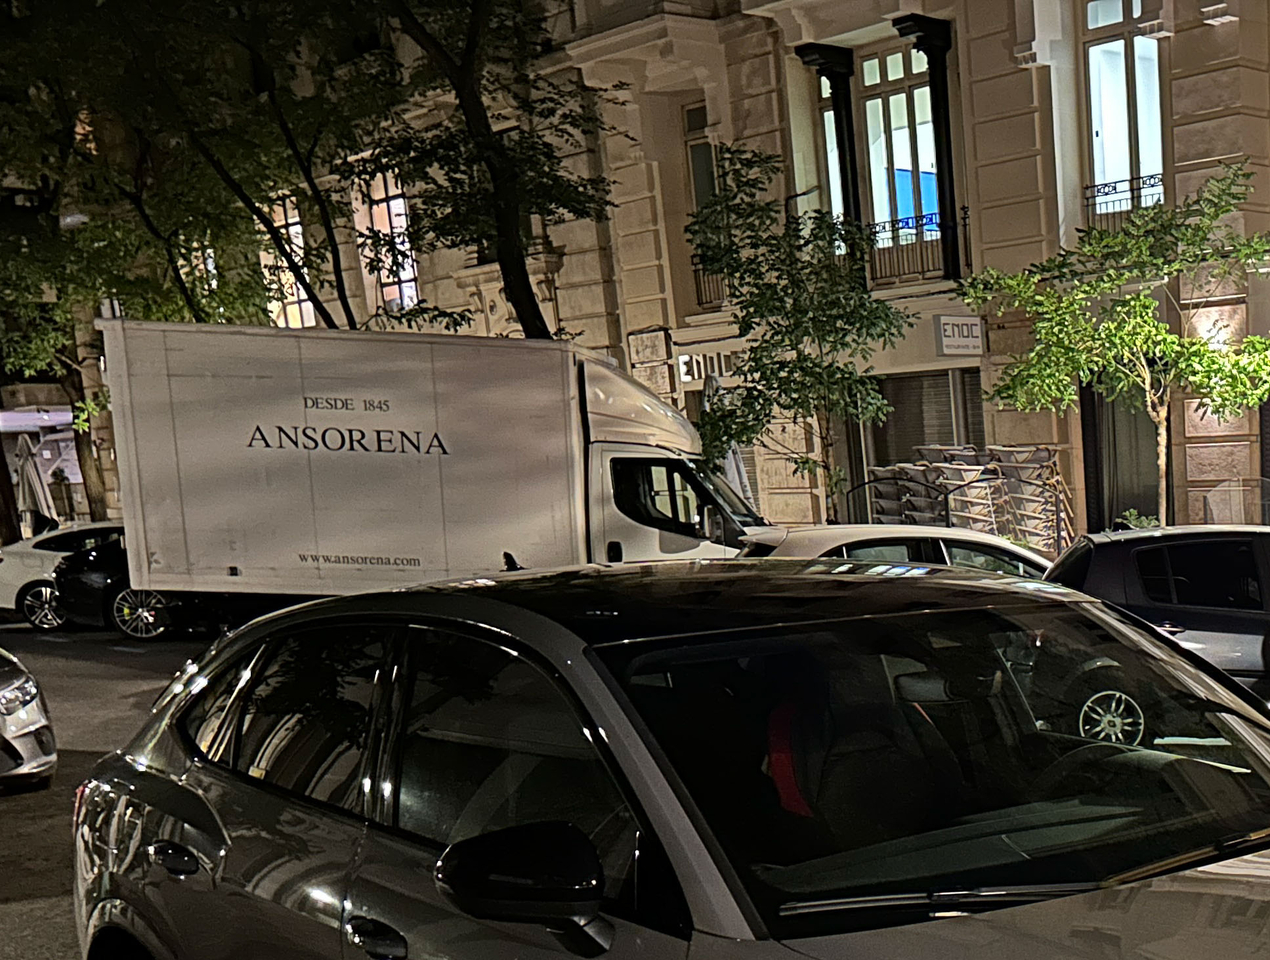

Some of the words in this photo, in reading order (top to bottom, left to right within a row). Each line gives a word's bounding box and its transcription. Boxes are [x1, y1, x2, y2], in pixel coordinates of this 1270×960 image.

[942, 322, 980, 339] ENOC
[303, 396, 355, 411] DESDE
[362, 399, 390, 412] 1845
[246, 424, 450, 456] ANSORENA
[298, 553, 422, 567] www.ansorena.com
